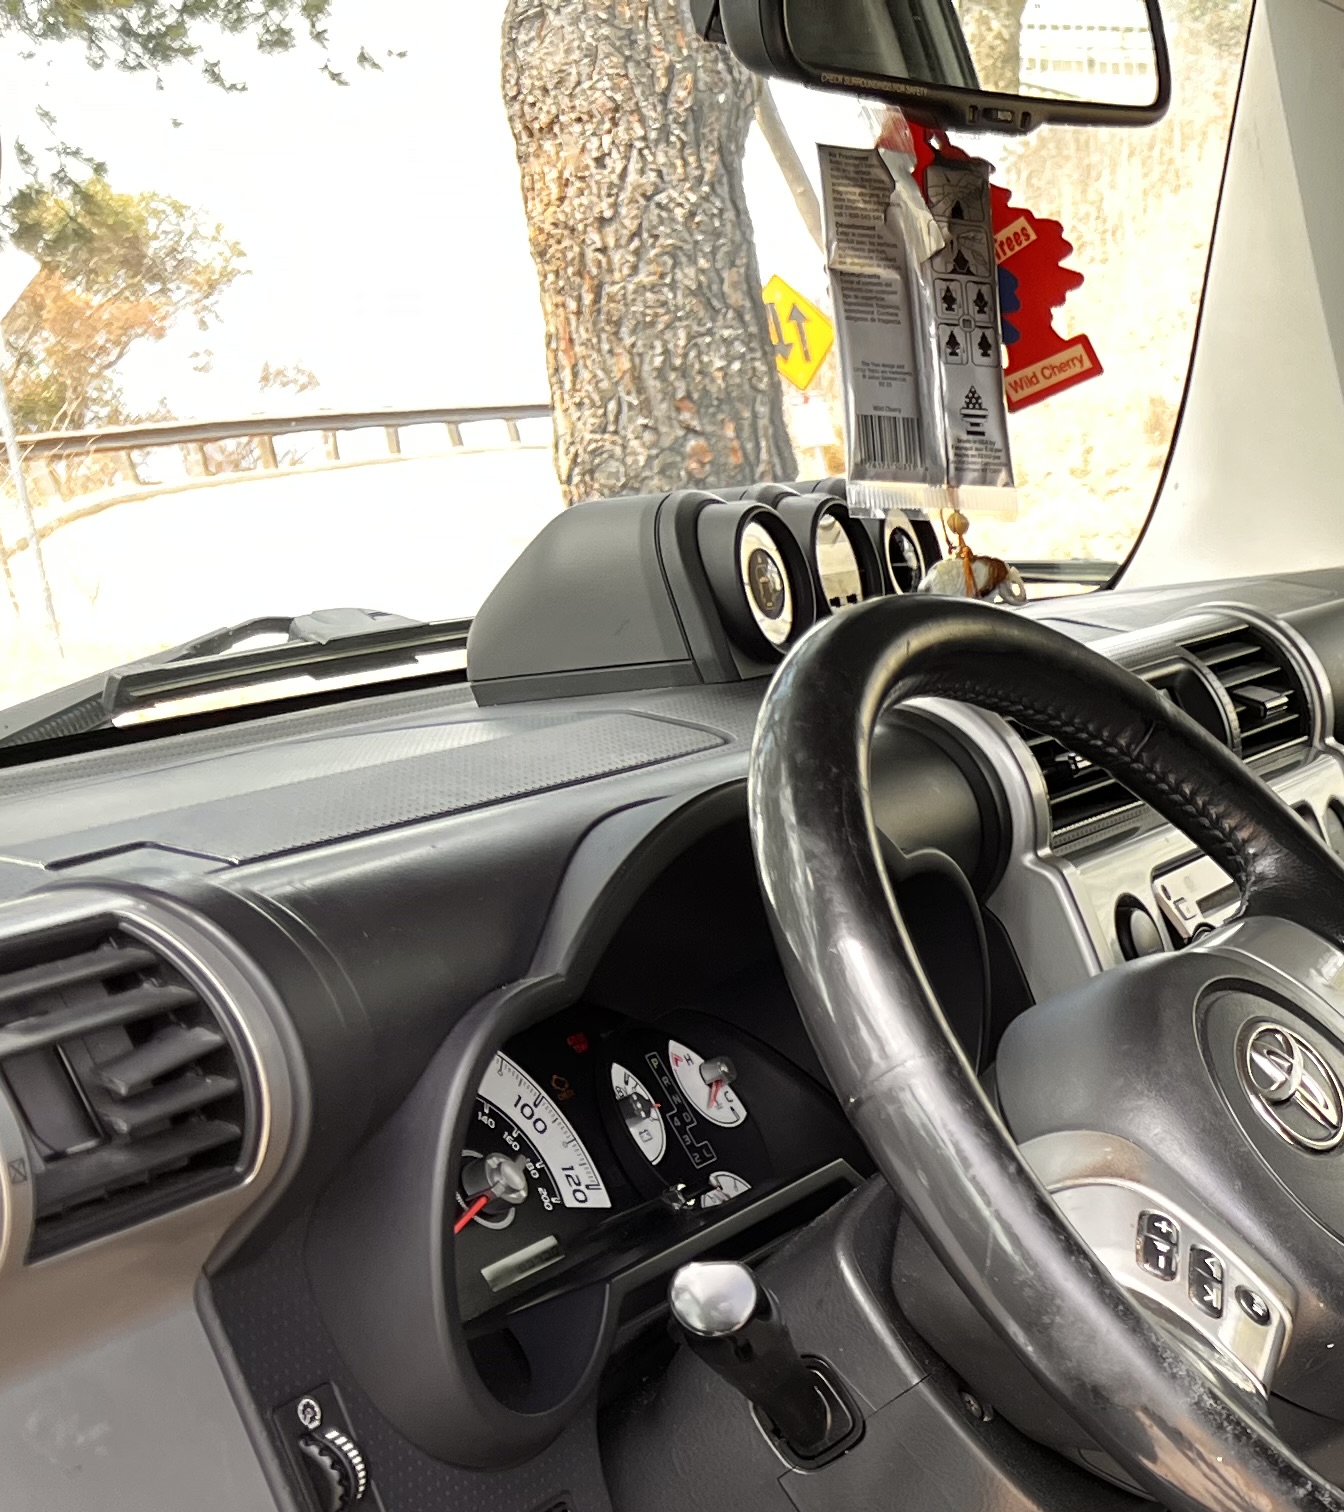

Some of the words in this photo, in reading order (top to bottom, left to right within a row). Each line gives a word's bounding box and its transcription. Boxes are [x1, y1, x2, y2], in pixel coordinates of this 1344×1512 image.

[1008, 372, 1039, 395] Wild
[1041, 353, 1086, 383] Cherry
[651, 1058, 659, 1069] P
[661, 1076, 671, 1087] R
[682, 1112, 692, 1123] D
[477, 1111, 496, 1129] 140
[513, 1094, 548, 1135] 100
[503, 1131, 520, 1151] 160
[673, 1116, 681, 1127] 4
[692, 1153, 701, 1163] 2
[537, 1187, 554, 1211] 200
[561, 1165, 589, 1204] 120
